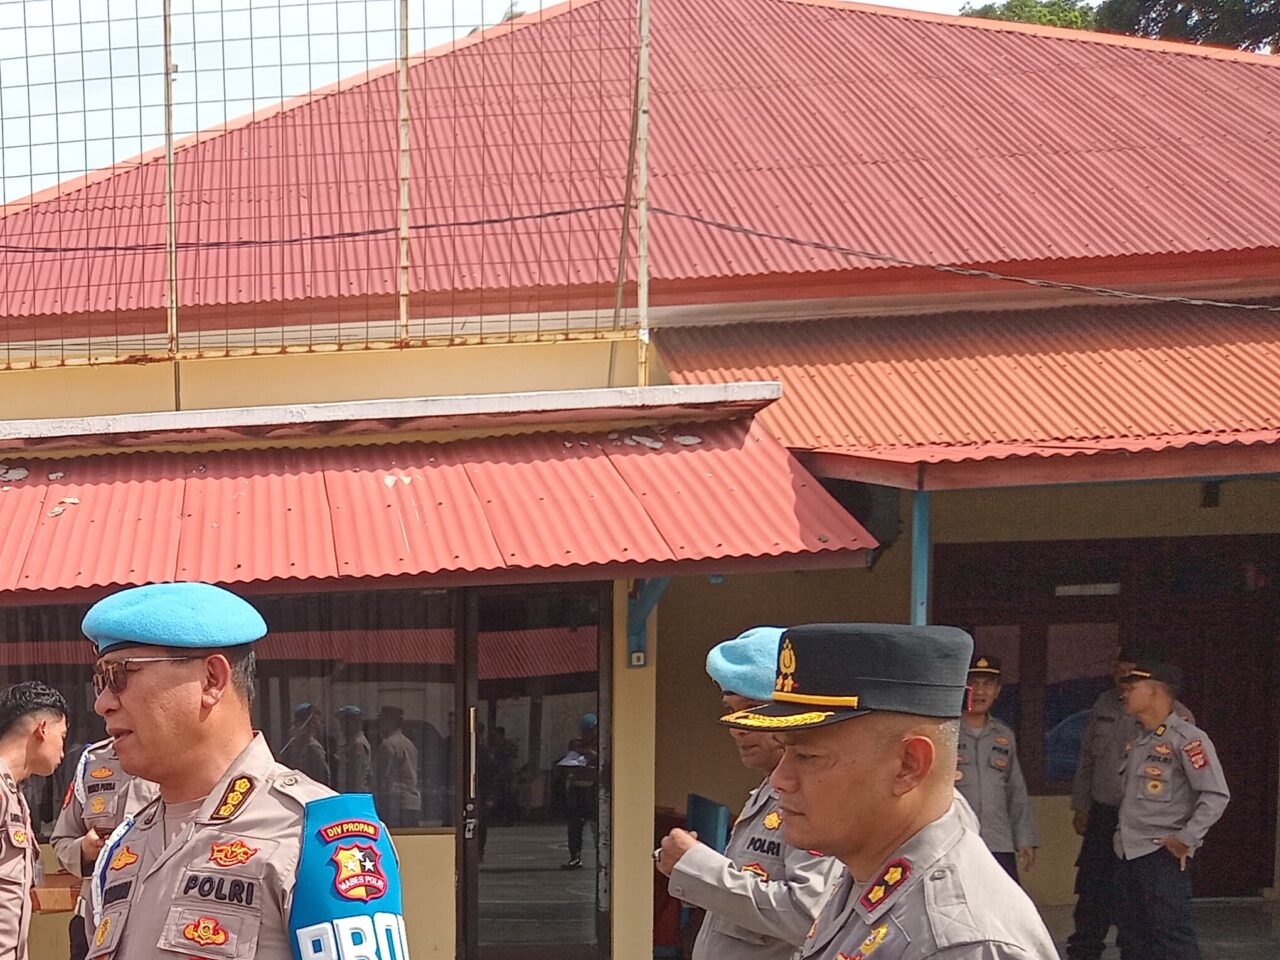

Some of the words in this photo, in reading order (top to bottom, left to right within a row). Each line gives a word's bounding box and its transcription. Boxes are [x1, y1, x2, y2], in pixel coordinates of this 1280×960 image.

[326, 825, 342, 837] DIV
[342, 823, 376, 835] PROPAM
[746, 836, 781, 857] POLRI
[183, 874, 255, 906] POLRI
[338, 876, 364, 891] MABES
[364, 875, 385, 888] POLRI
